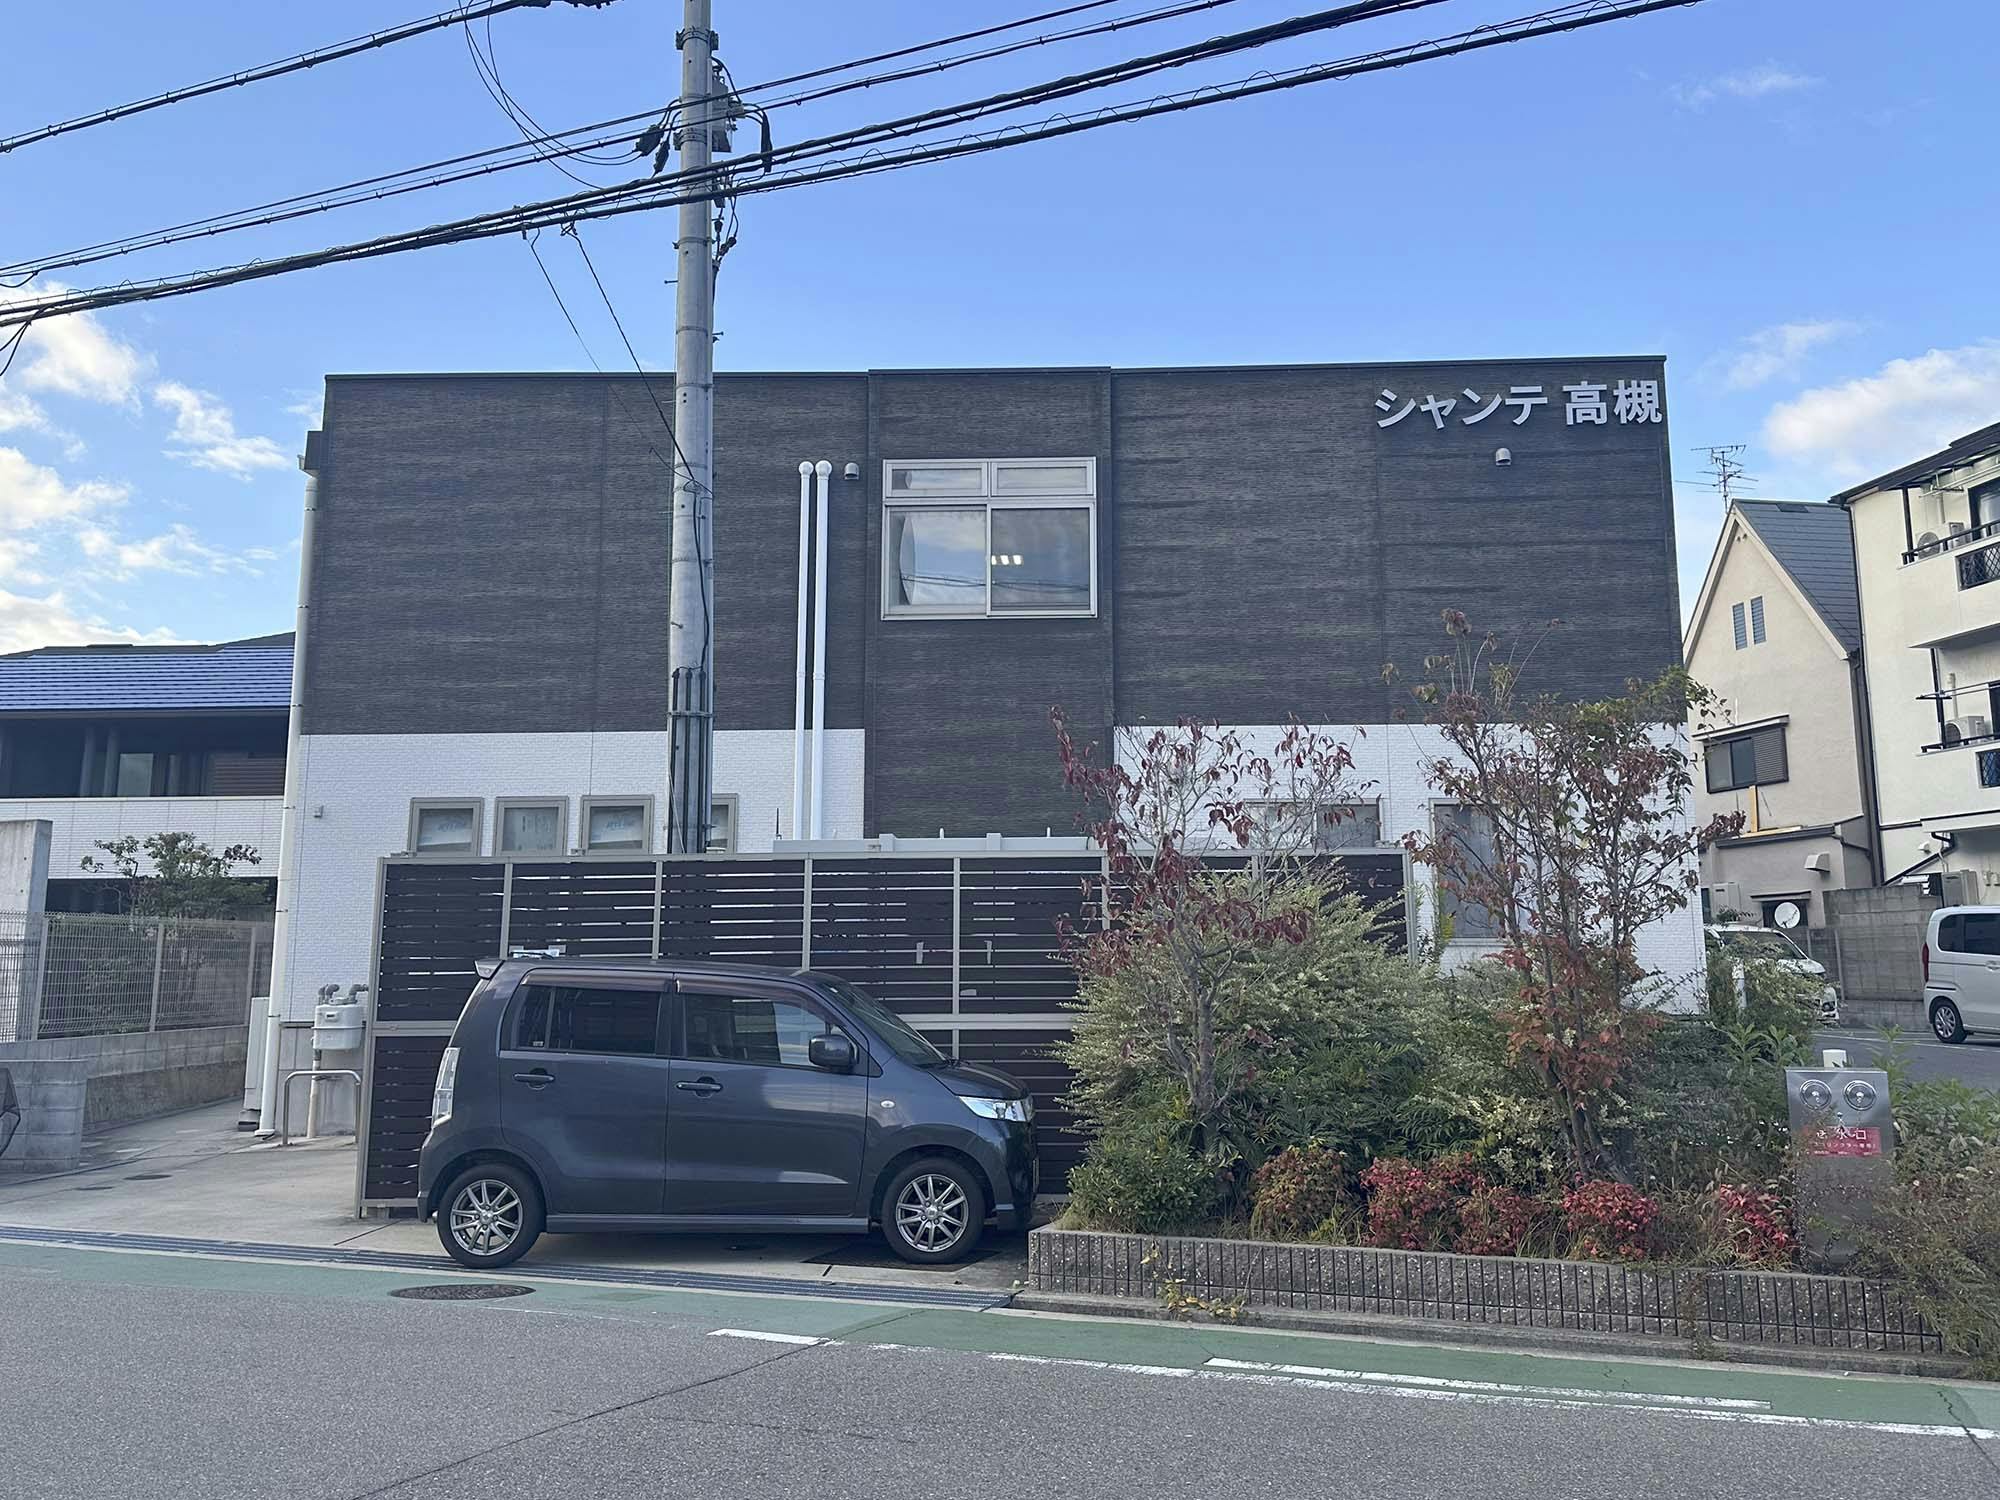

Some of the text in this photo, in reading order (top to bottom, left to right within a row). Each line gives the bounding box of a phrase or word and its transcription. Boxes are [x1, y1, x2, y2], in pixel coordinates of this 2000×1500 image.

[1375, 379, 1662, 430] シャンテ 高槻
